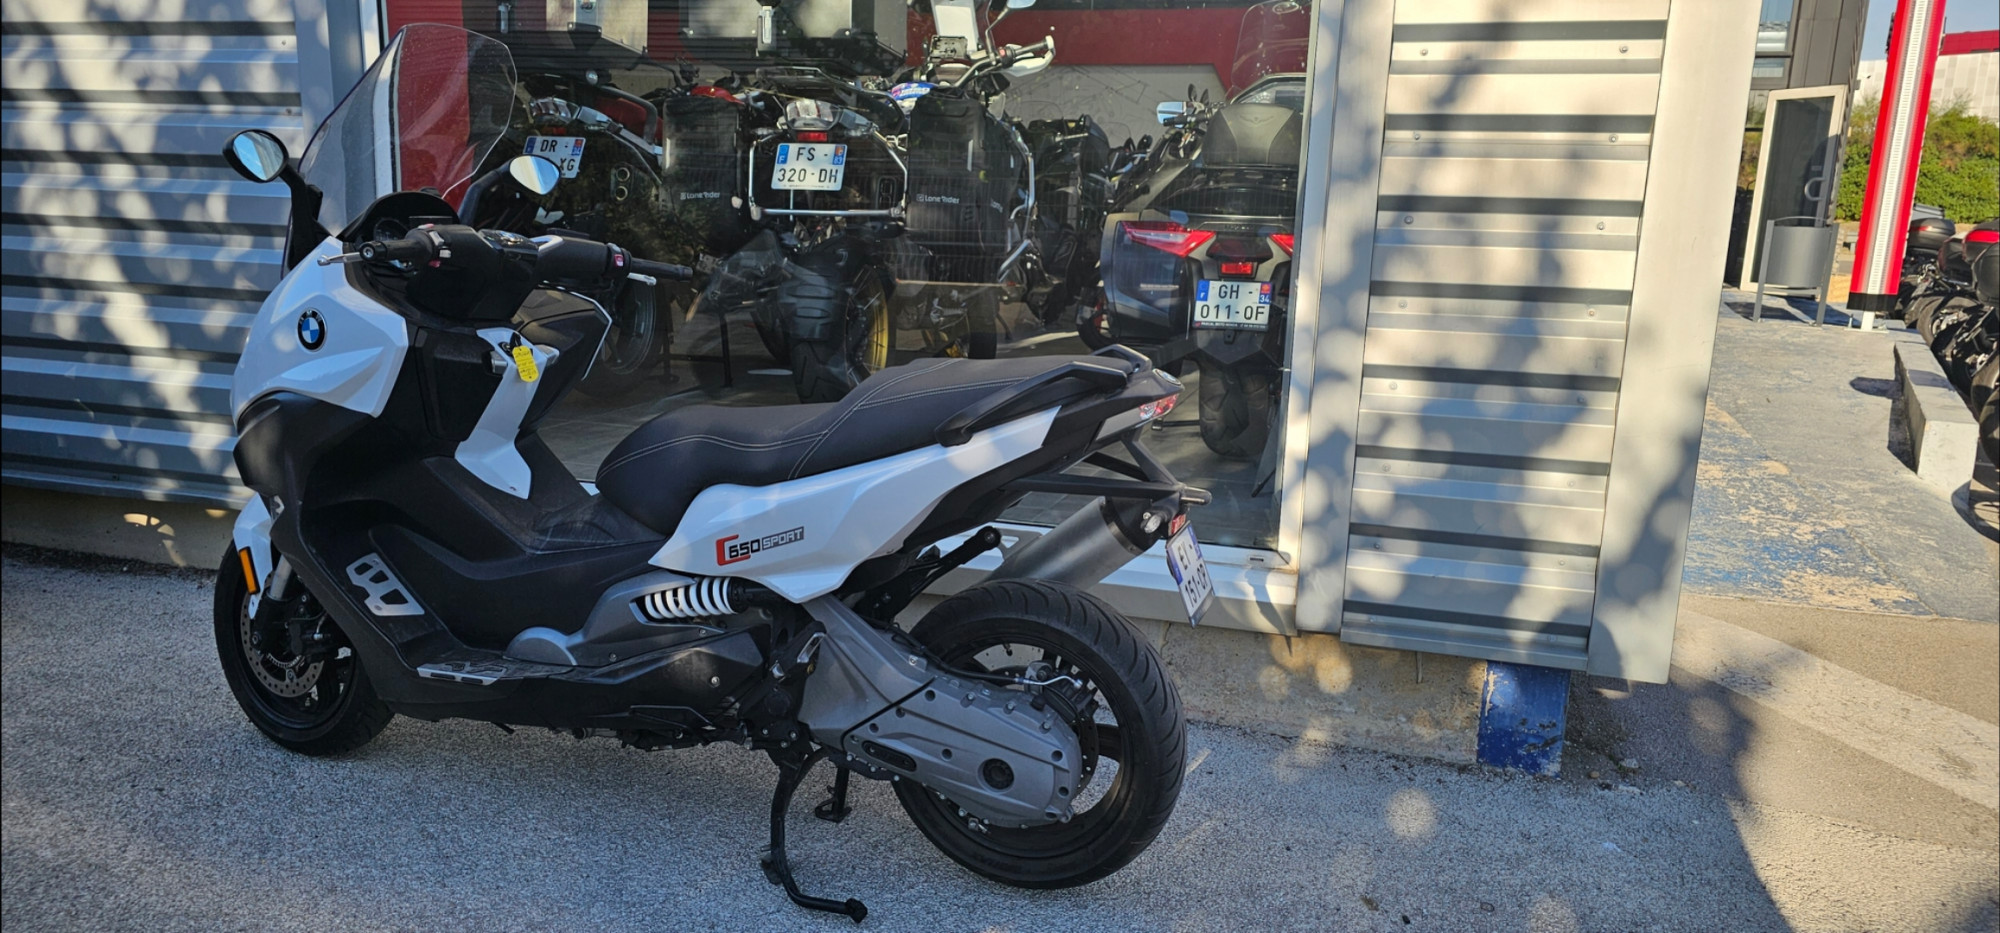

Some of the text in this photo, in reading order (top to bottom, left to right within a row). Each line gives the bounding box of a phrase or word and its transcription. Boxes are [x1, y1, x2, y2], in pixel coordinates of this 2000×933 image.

[540, 139, 558, 152] DR
[796, 147, 816, 161] FS
[777, 168, 839, 184] 320-DH
[1218, 284, 1240, 299] GH
[1259, 294, 1270, 303] 34
[762, 528, 803, 550] SPORT
